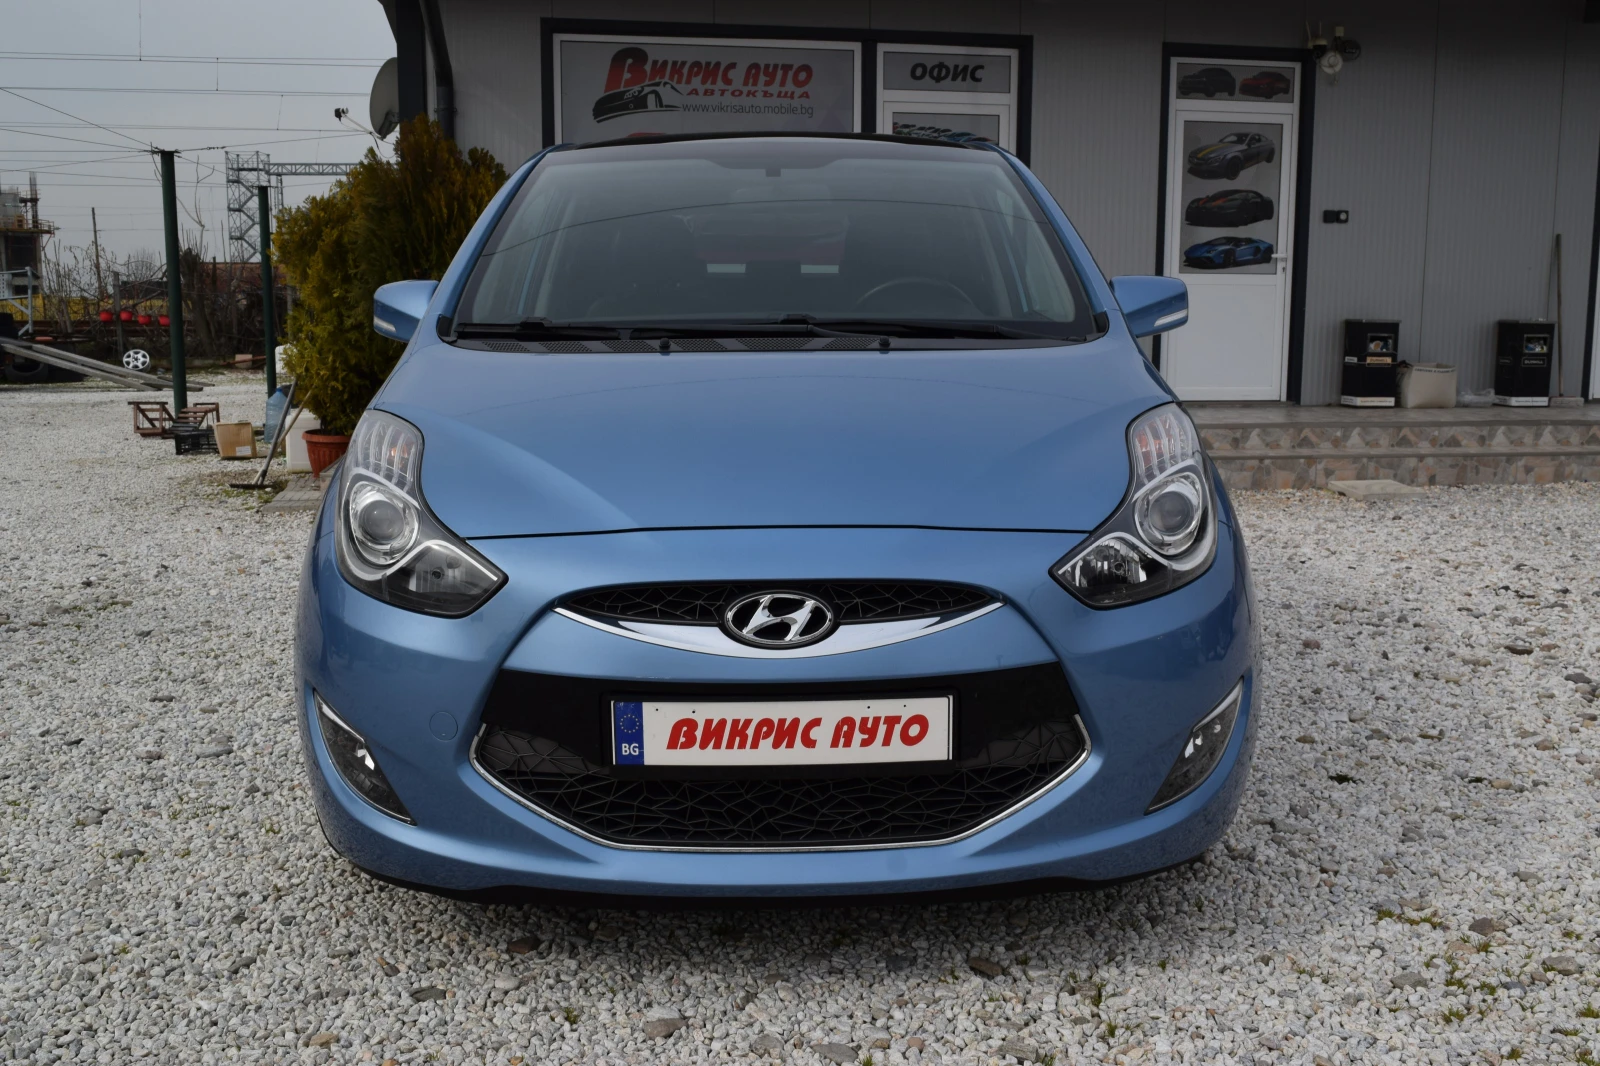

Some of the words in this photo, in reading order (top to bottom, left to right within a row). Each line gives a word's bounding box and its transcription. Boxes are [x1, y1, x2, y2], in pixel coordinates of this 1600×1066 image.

[742, 62, 814, 89] АУТО
[910, 62, 985, 83] ОФИС
[686, 87, 811, 99] АВТОКЪЩА
[682, 102, 814, 118] www.vikrisauto.mobile.bg
[666, 717, 823, 751] ВИКРИС
[830, 714, 930, 748] АУТО
[621, 743, 639, 756] BG
